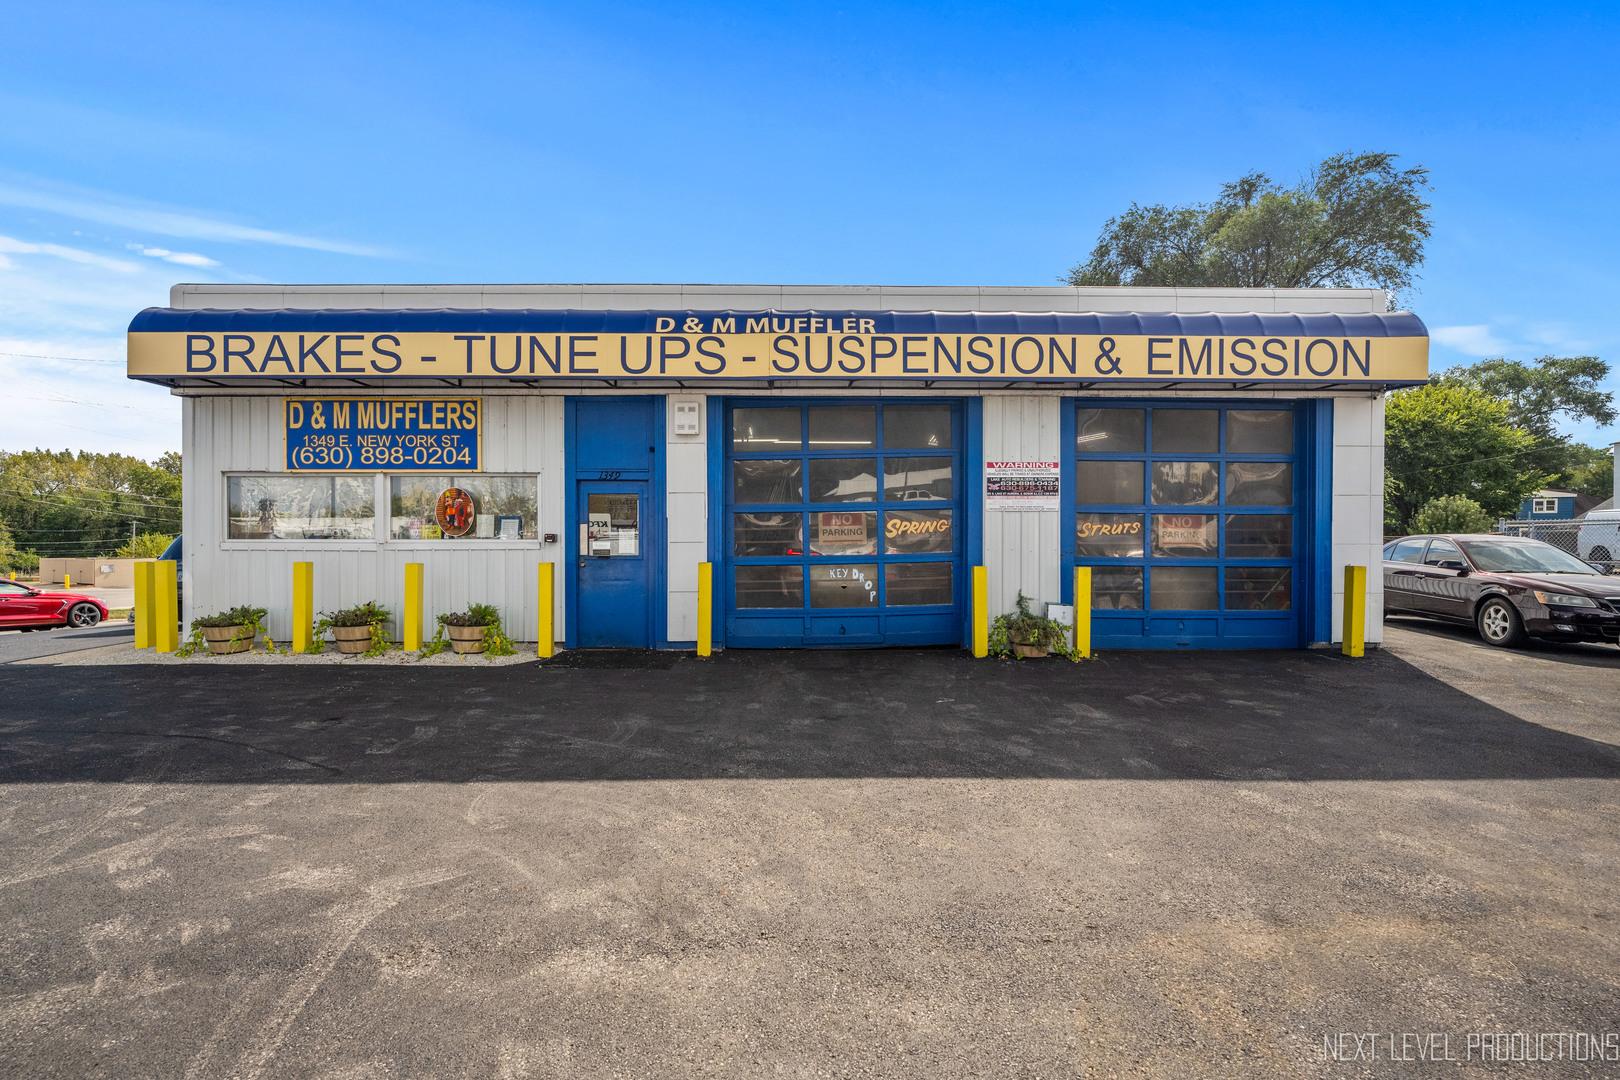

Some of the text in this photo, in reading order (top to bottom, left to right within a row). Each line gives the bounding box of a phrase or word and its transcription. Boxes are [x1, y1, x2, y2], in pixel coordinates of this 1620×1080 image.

[655, 316, 876, 334] D & M MUFFLER
[185, 334, 402, 374] BRAKES
[453, 334, 599, 375] TUNE
[619, 334, 727, 375] UPS
[771, 334, 1077, 376] SUSPENSION
[1094, 336, 1123, 376] &
[1147, 337, 1371, 378] EMISSION
[289, 401, 477, 430] D & M MUFFLERS
[303, 434, 464, 447] 1349 E. NEW YORK ST.
[291, 446, 472, 468] (630) 898-0204
[831, 514, 853, 526] NO
[885, 518, 950, 539] SPRING
[1172, 517, 1192, 528] NO
[822, 527, 863, 537] PARKING
[1077, 521, 1142, 538] STRUTS
[829, 568, 877, 603] KEY DROP
